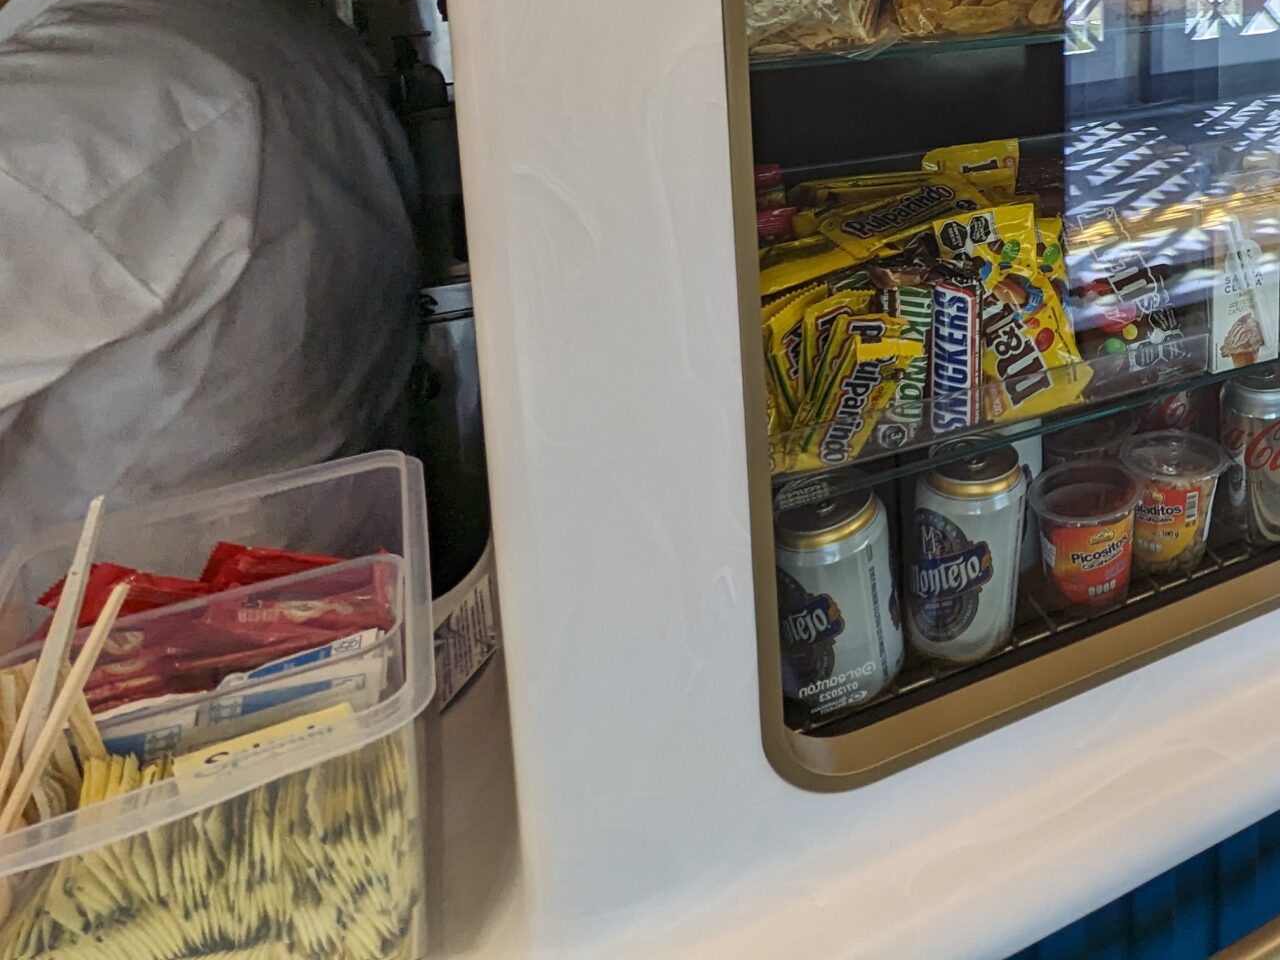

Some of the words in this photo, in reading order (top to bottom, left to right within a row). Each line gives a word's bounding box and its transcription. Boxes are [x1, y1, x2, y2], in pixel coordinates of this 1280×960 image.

[841, 184, 955, 238] Pulparindo
[932, 287, 968, 431] SNICKERS
[820, 356, 889, 465] ulparindo
[1135, 505, 1182, 517] aladitos
[1071, 535, 1129, 564] Picositos
